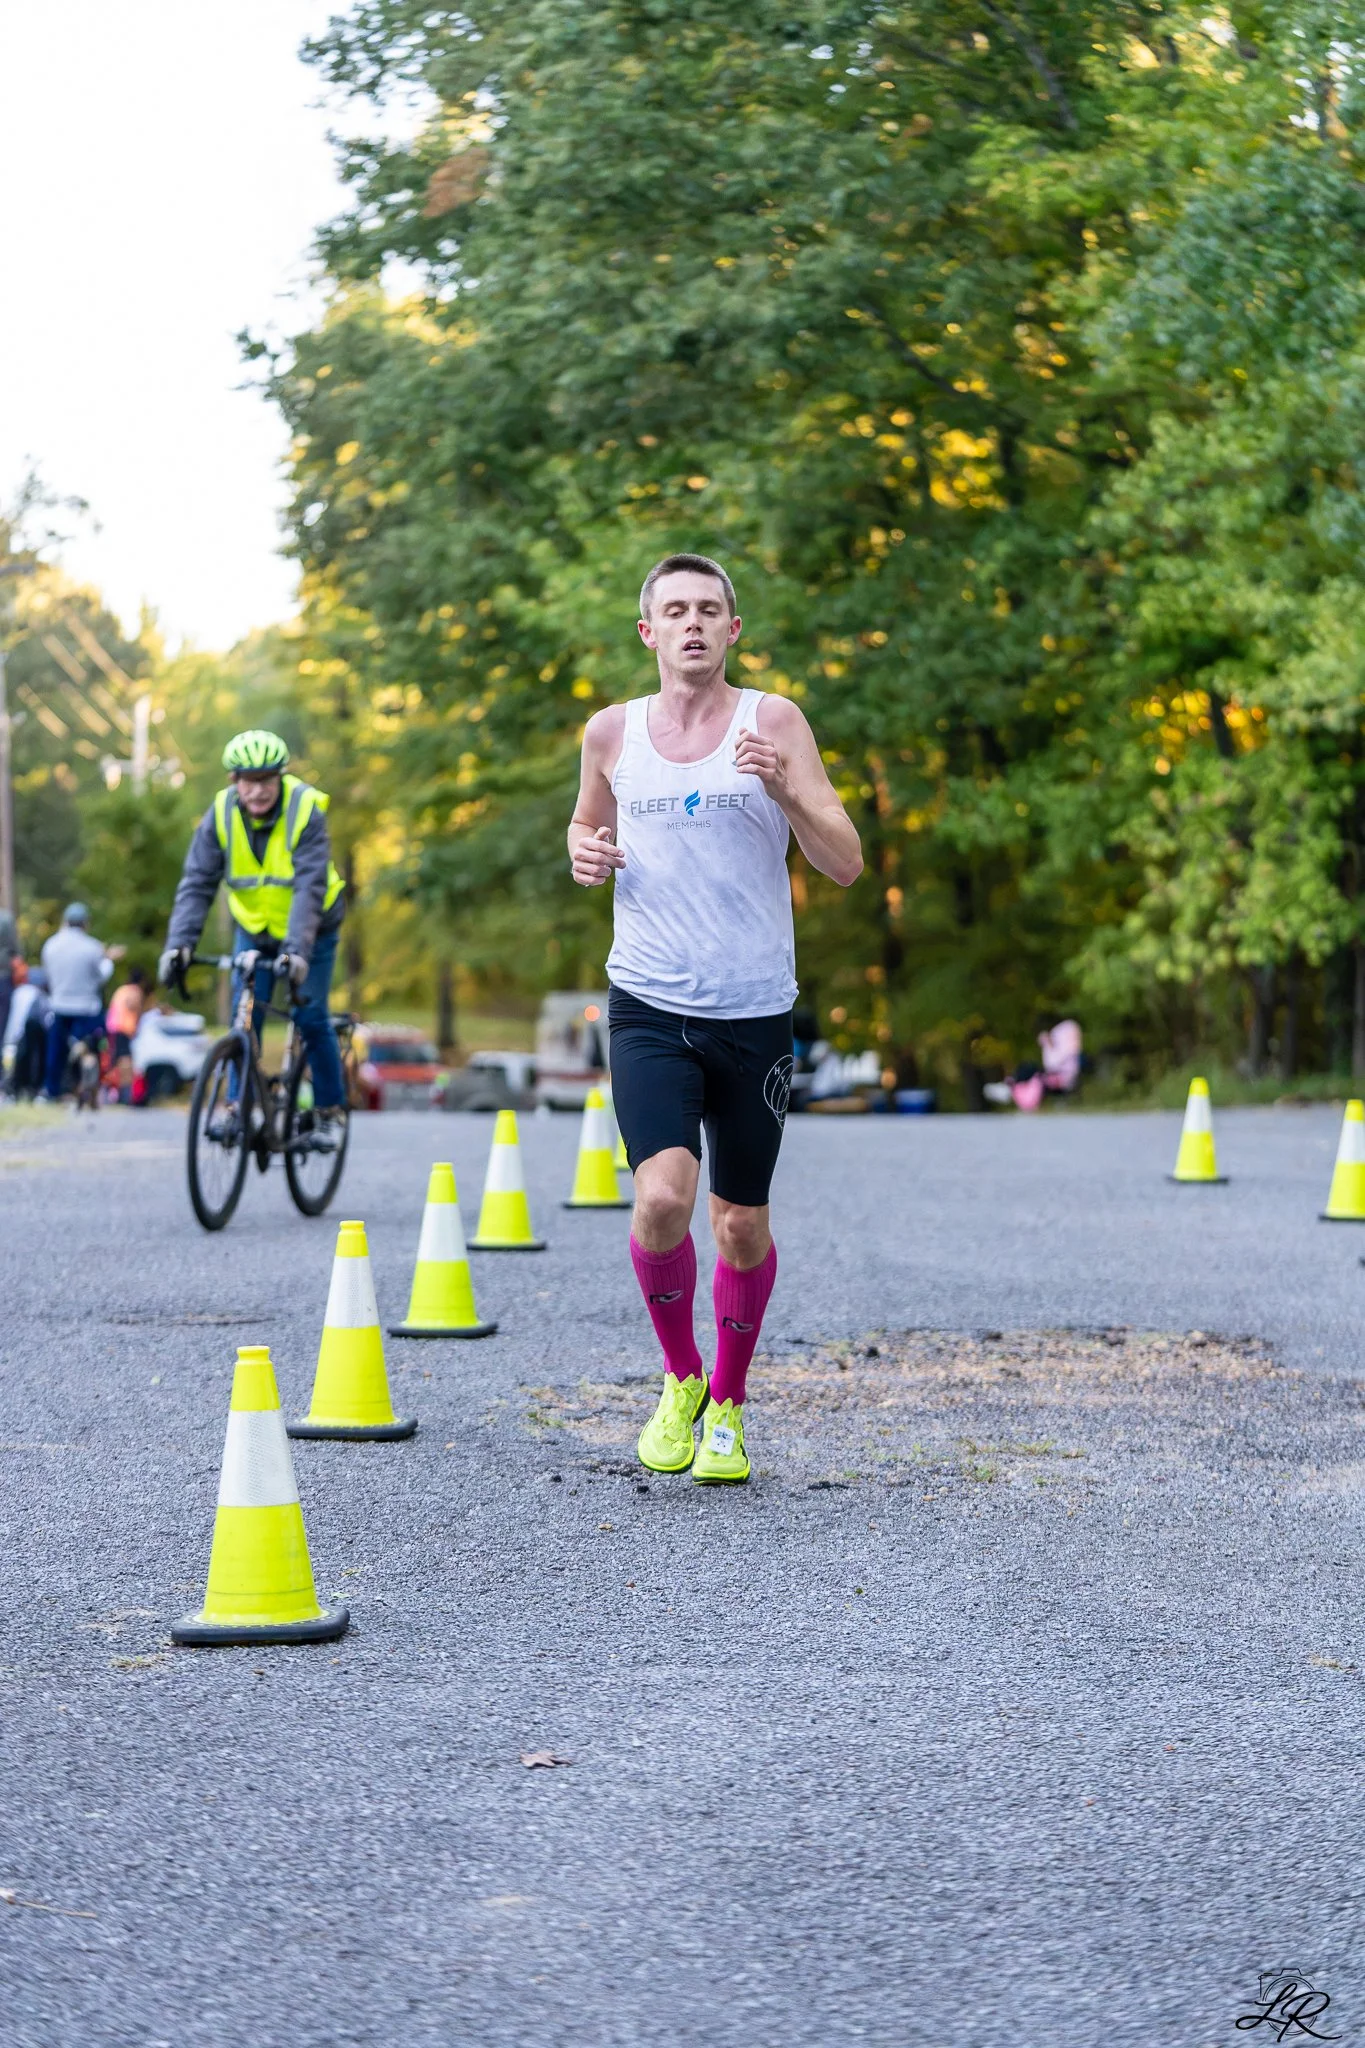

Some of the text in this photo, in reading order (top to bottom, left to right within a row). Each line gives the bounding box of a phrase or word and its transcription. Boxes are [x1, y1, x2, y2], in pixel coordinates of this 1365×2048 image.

[630, 793, 750, 816] FLEET FEET
[666, 819, 712, 831] MEMPHIS
